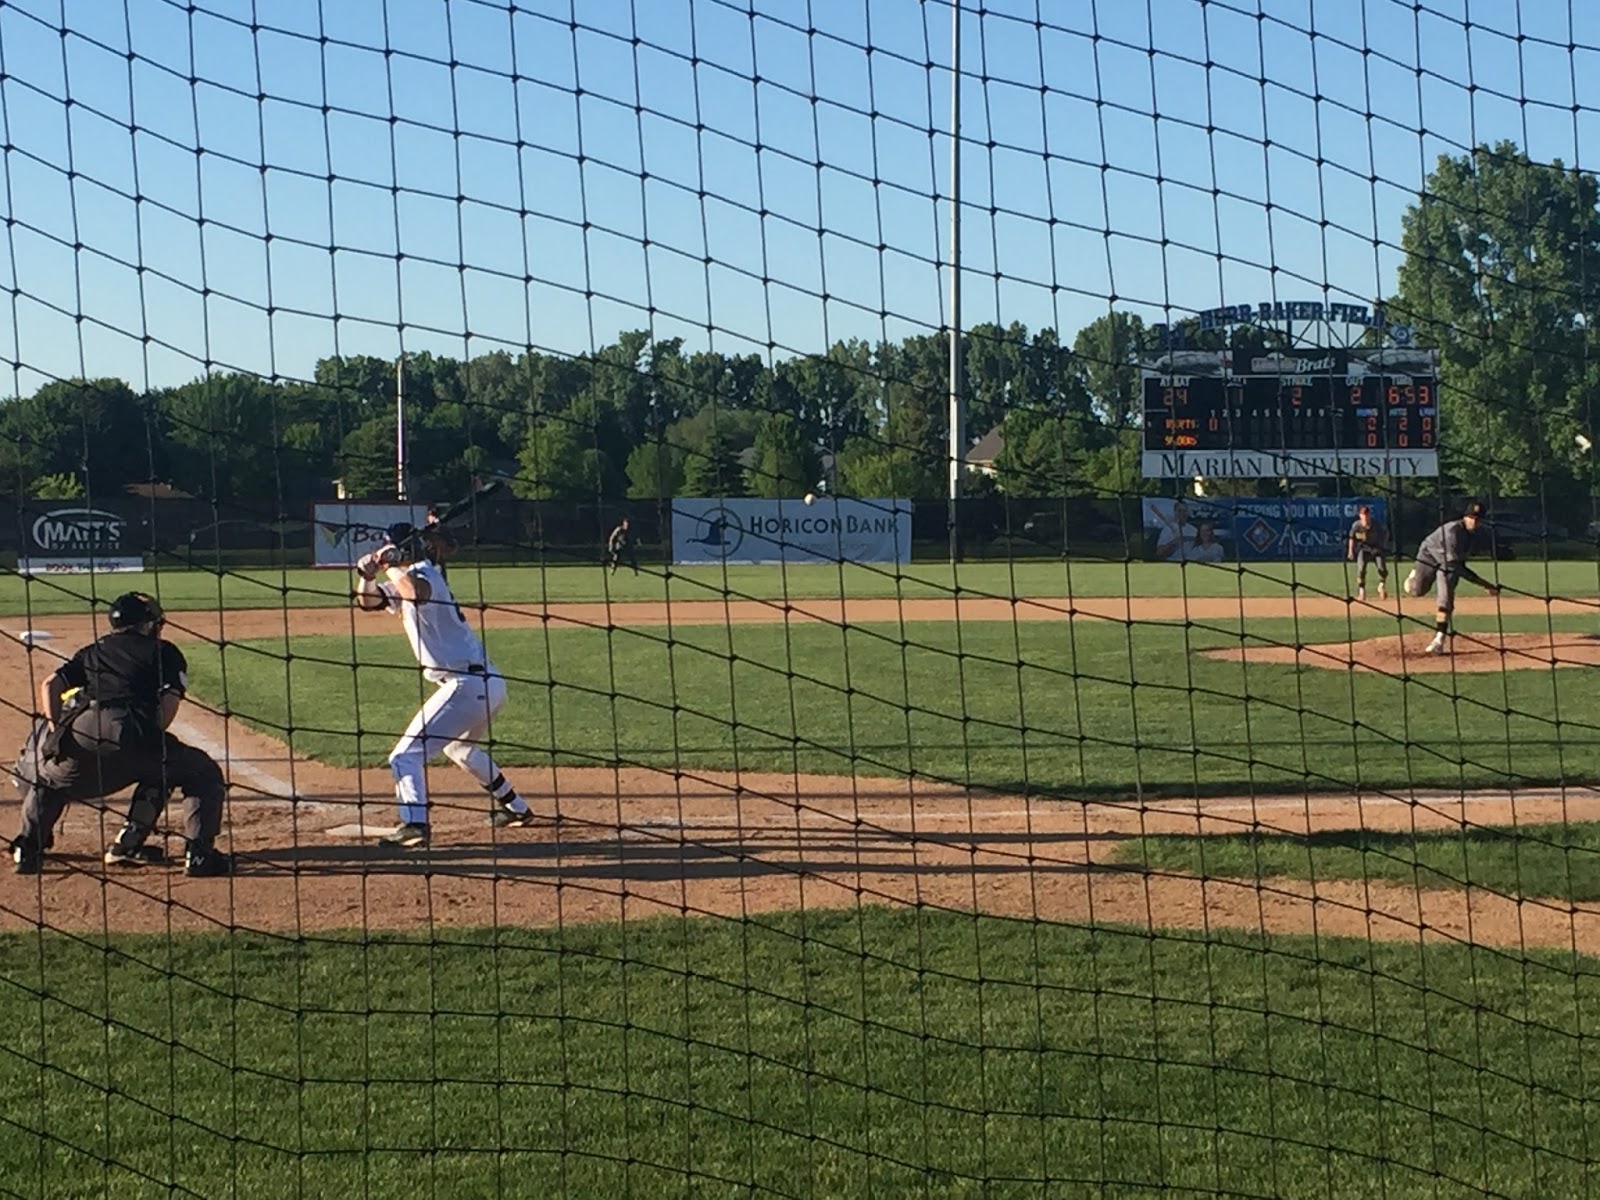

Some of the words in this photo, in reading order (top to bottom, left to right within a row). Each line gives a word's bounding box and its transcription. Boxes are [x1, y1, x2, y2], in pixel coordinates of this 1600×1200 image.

[1330, 302, 1385, 328] FIELD
[1161, 453, 1262, 476] MARIAN
[1272, 453, 1424, 476] UNIVERSITY
[750, 515, 843, 534] HORICON
[846, 514, 899, 534] BANK
